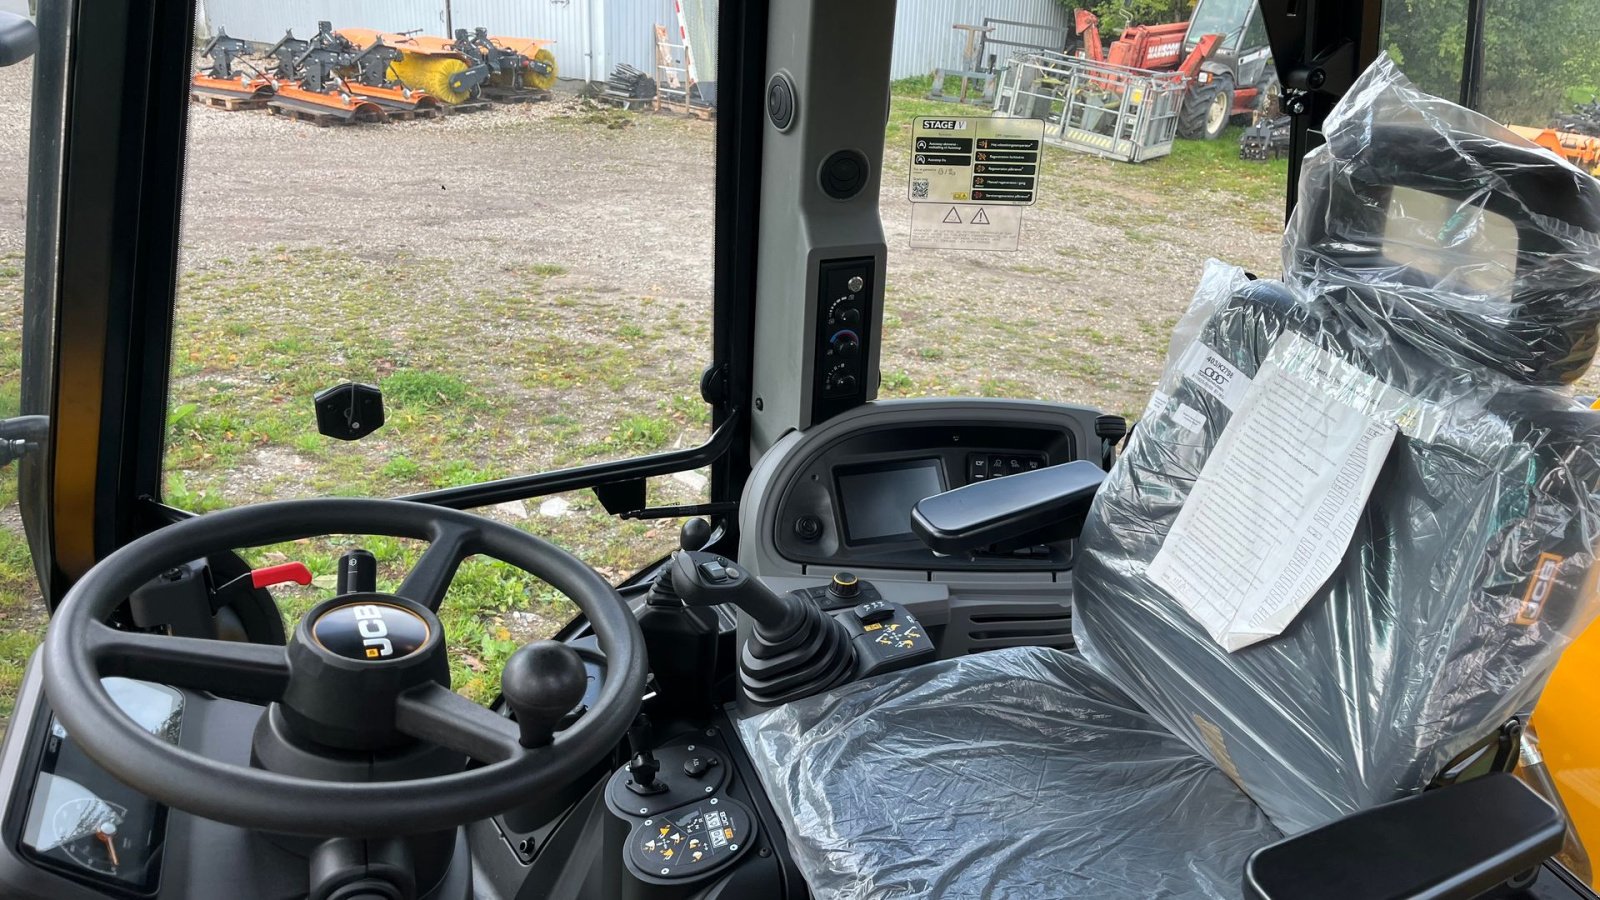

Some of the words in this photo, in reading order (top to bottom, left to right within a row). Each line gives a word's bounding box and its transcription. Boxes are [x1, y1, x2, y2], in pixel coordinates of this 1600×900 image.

[924, 121, 954, 129] STAGE
[1524, 560, 1555, 619] JCB
[353, 604, 393, 657] JCB
[719, 811, 729, 826] JCB
